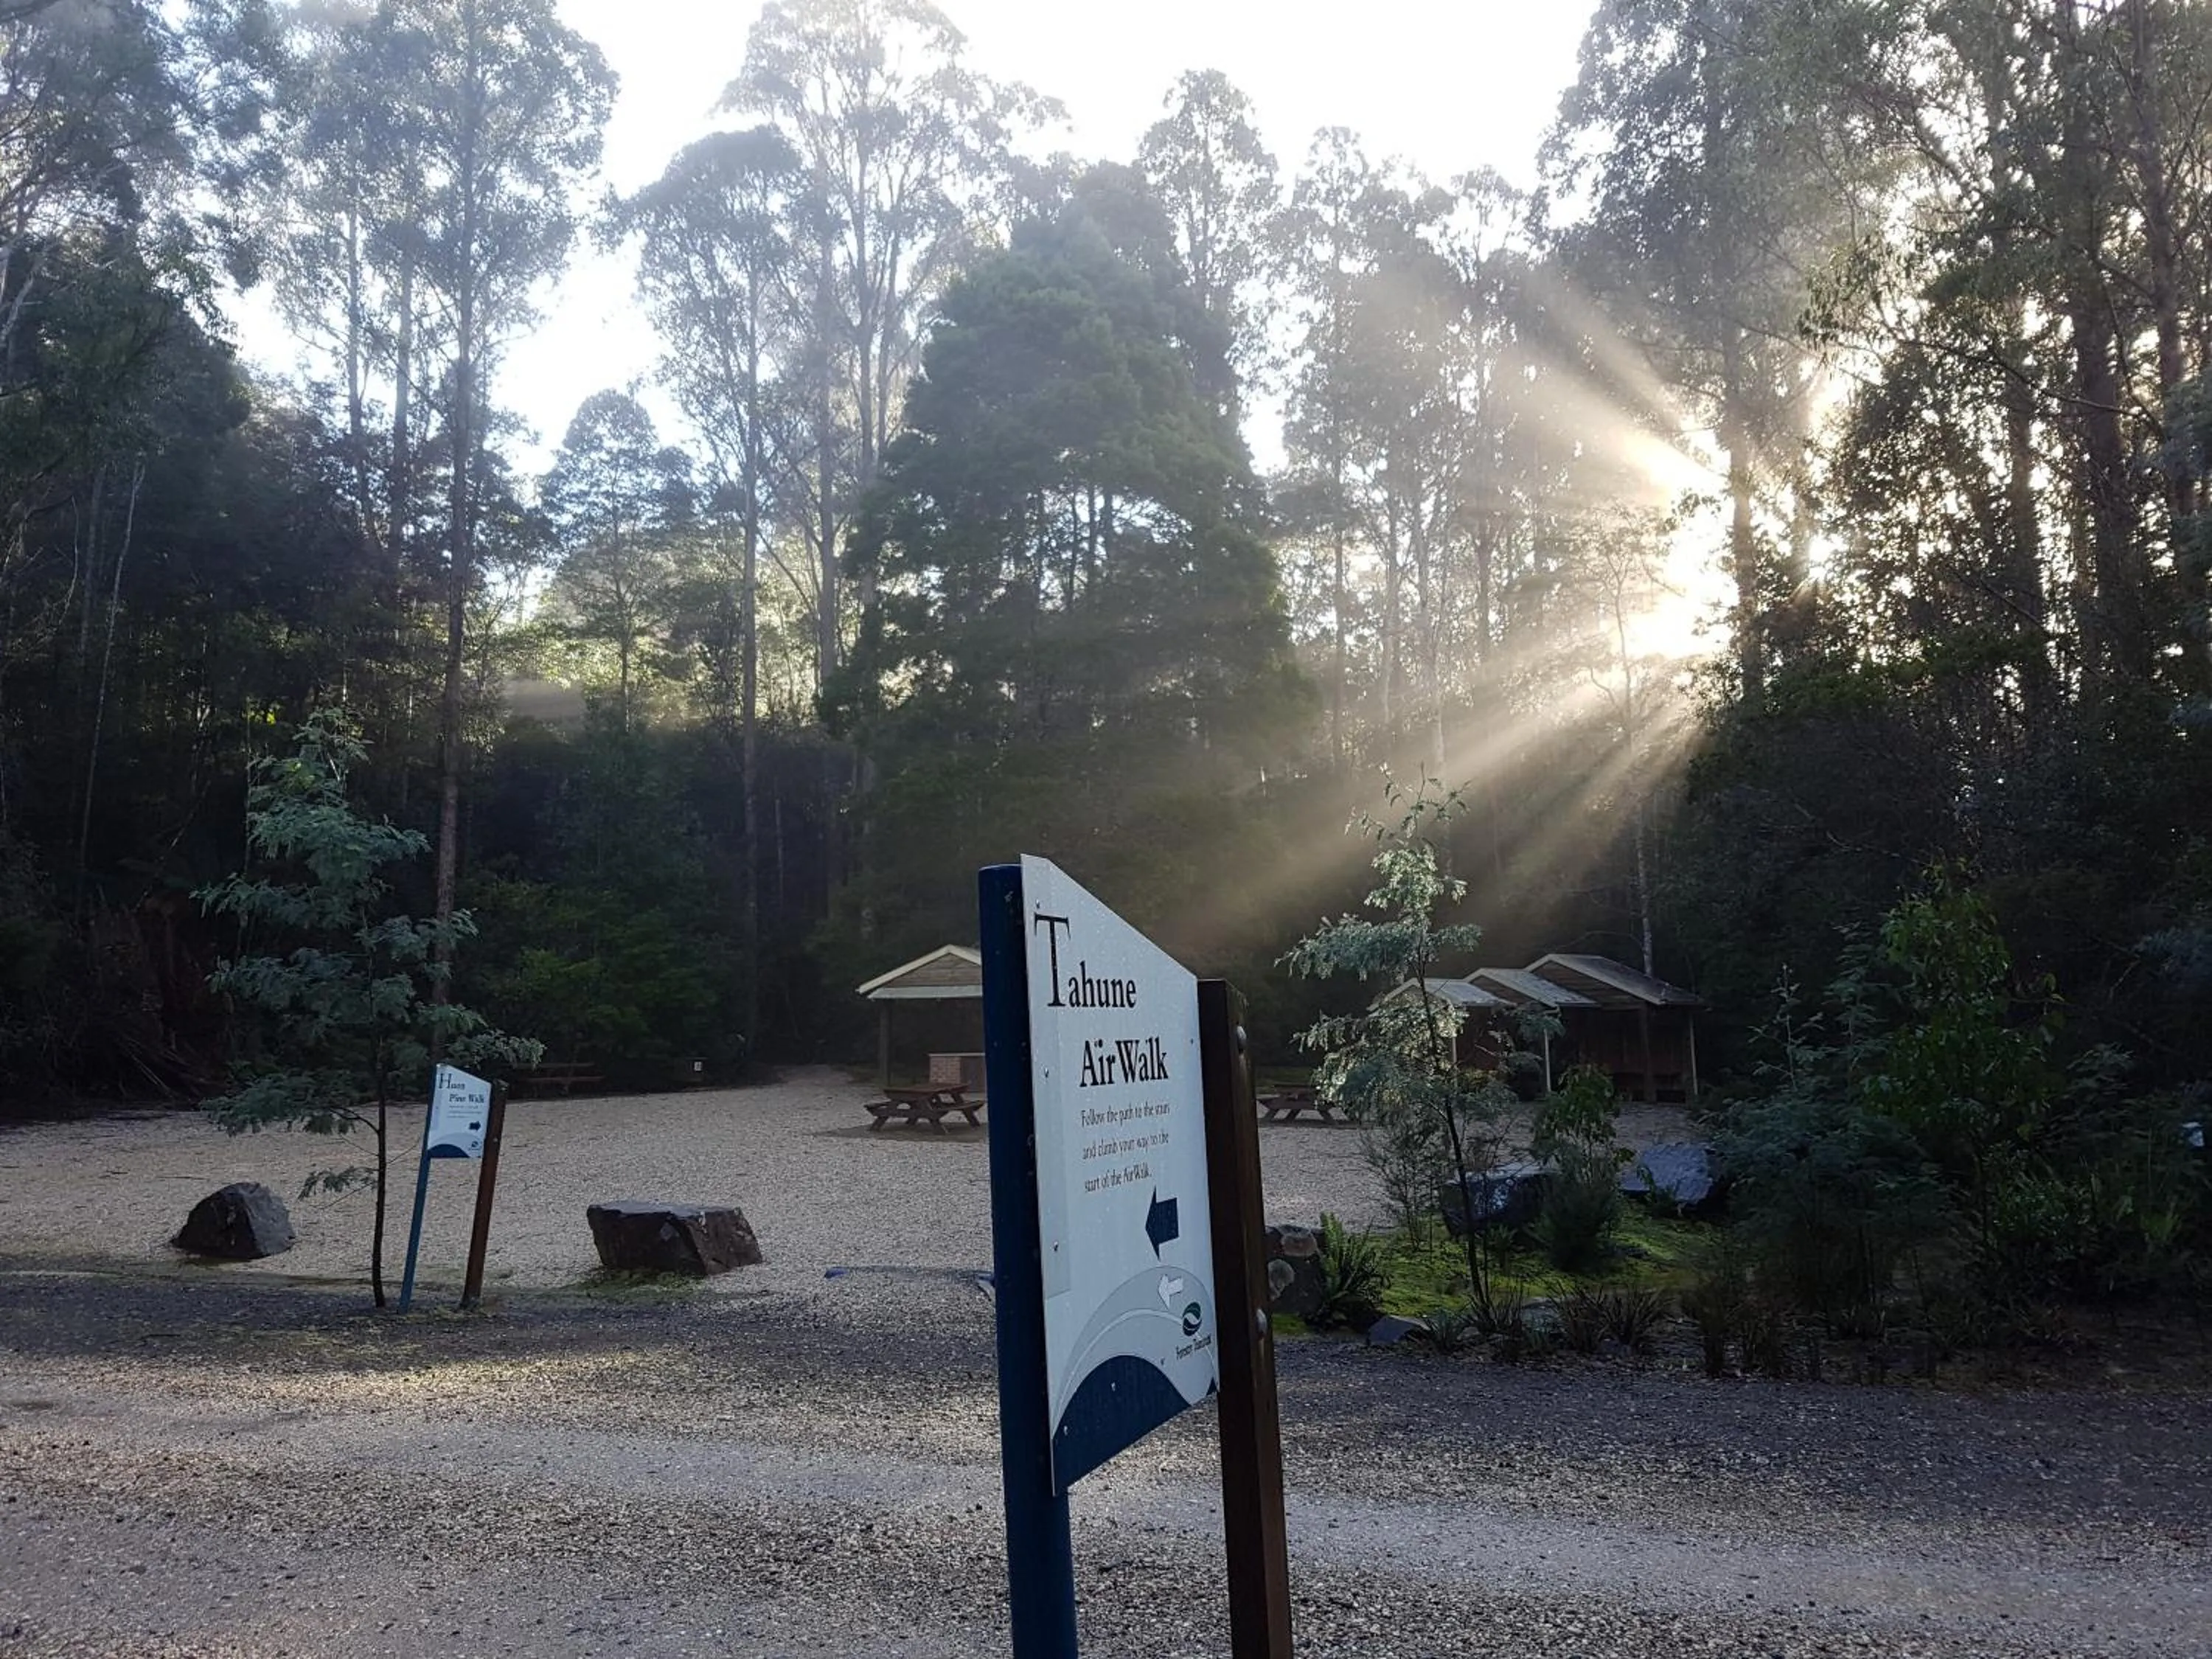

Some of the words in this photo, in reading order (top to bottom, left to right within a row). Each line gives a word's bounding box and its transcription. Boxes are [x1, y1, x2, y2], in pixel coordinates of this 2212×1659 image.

[1033, 911, 1138, 1008] Tahune
[1079, 1036, 1169, 1088] AirWalk
[438, 1073, 465, 1090] Huon
[448, 1093, 466, 1103] Pine
[468, 1093, 484, 1104] Walk
[1081, 1108, 1105, 1127] Follow
[1107, 1105, 1118, 1123] the
[1119, 1102, 1133, 1127] path
[1135, 1105, 1142, 1119] to
[1144, 1101, 1154, 1116] the
[1082, 1140, 1096, 1160] and
[1098, 1138, 1117, 1157] climb
[1119, 1140, 1135, 1156] your
[1136, 1137, 1148, 1152] way
[1150, 1134, 1158, 1144] to
[1158, 1130, 1169, 1145] the
[1085, 1177, 1100, 1192] start
[1102, 1169, 1110, 1188] of
[1110, 1169, 1121, 1186] the
